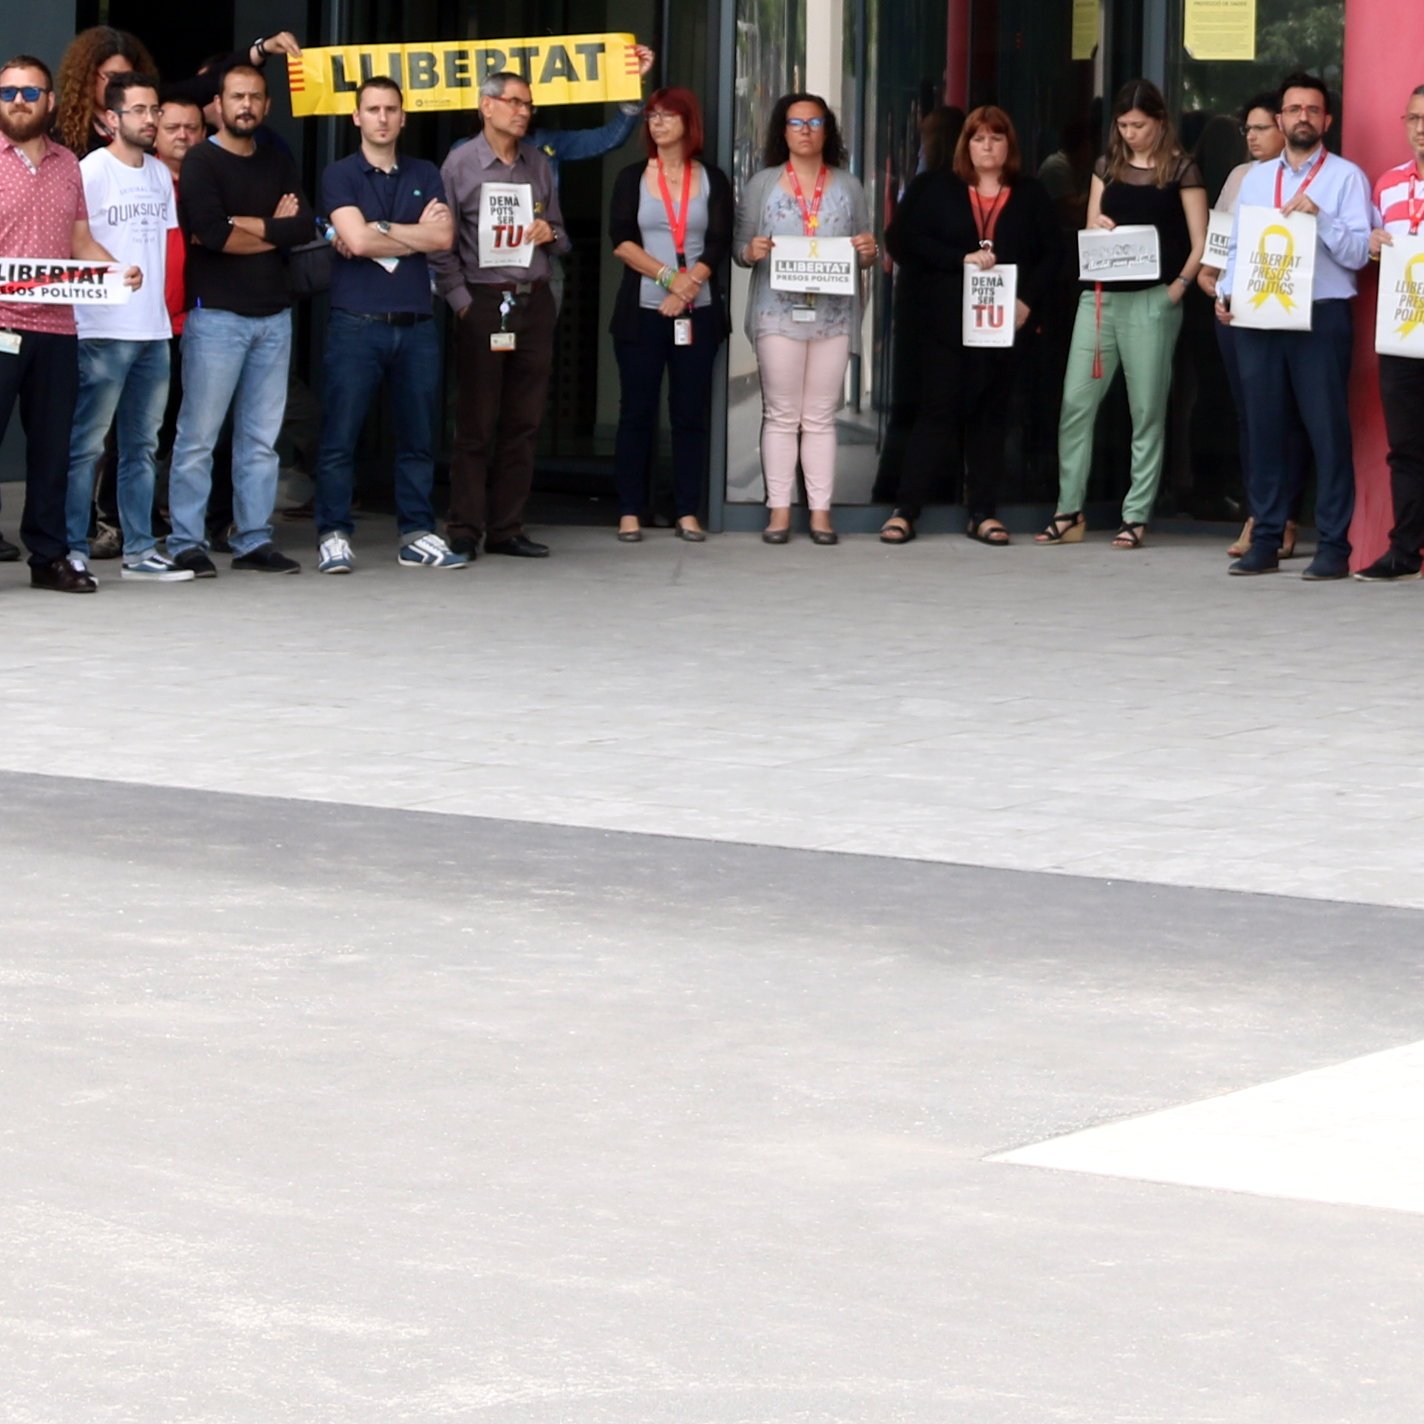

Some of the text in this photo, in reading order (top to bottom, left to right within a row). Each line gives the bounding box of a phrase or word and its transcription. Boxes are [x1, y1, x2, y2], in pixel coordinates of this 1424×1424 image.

[489, 194, 520, 207] DEMÀ
[108, 202, 168, 226] QUIKSILVE
[490, 207, 514, 216] POTS
[497, 216, 514, 224] SER
[492, 225, 523, 248] TU
[1211, 234, 1230, 248] LLI
[1249, 251, 1302, 268] LLIBERTAT
[778, 261, 848, 274] LLIBERTAT
[1251, 266, 1293, 282] PRESOS
[776, 274, 809, 282] PRESOS
[971, 275, 1004, 287] DEMÀ
[971, 287, 995, 296] POTS
[977, 296, 994, 304] SER
[972, 304, 1003, 328] TU
